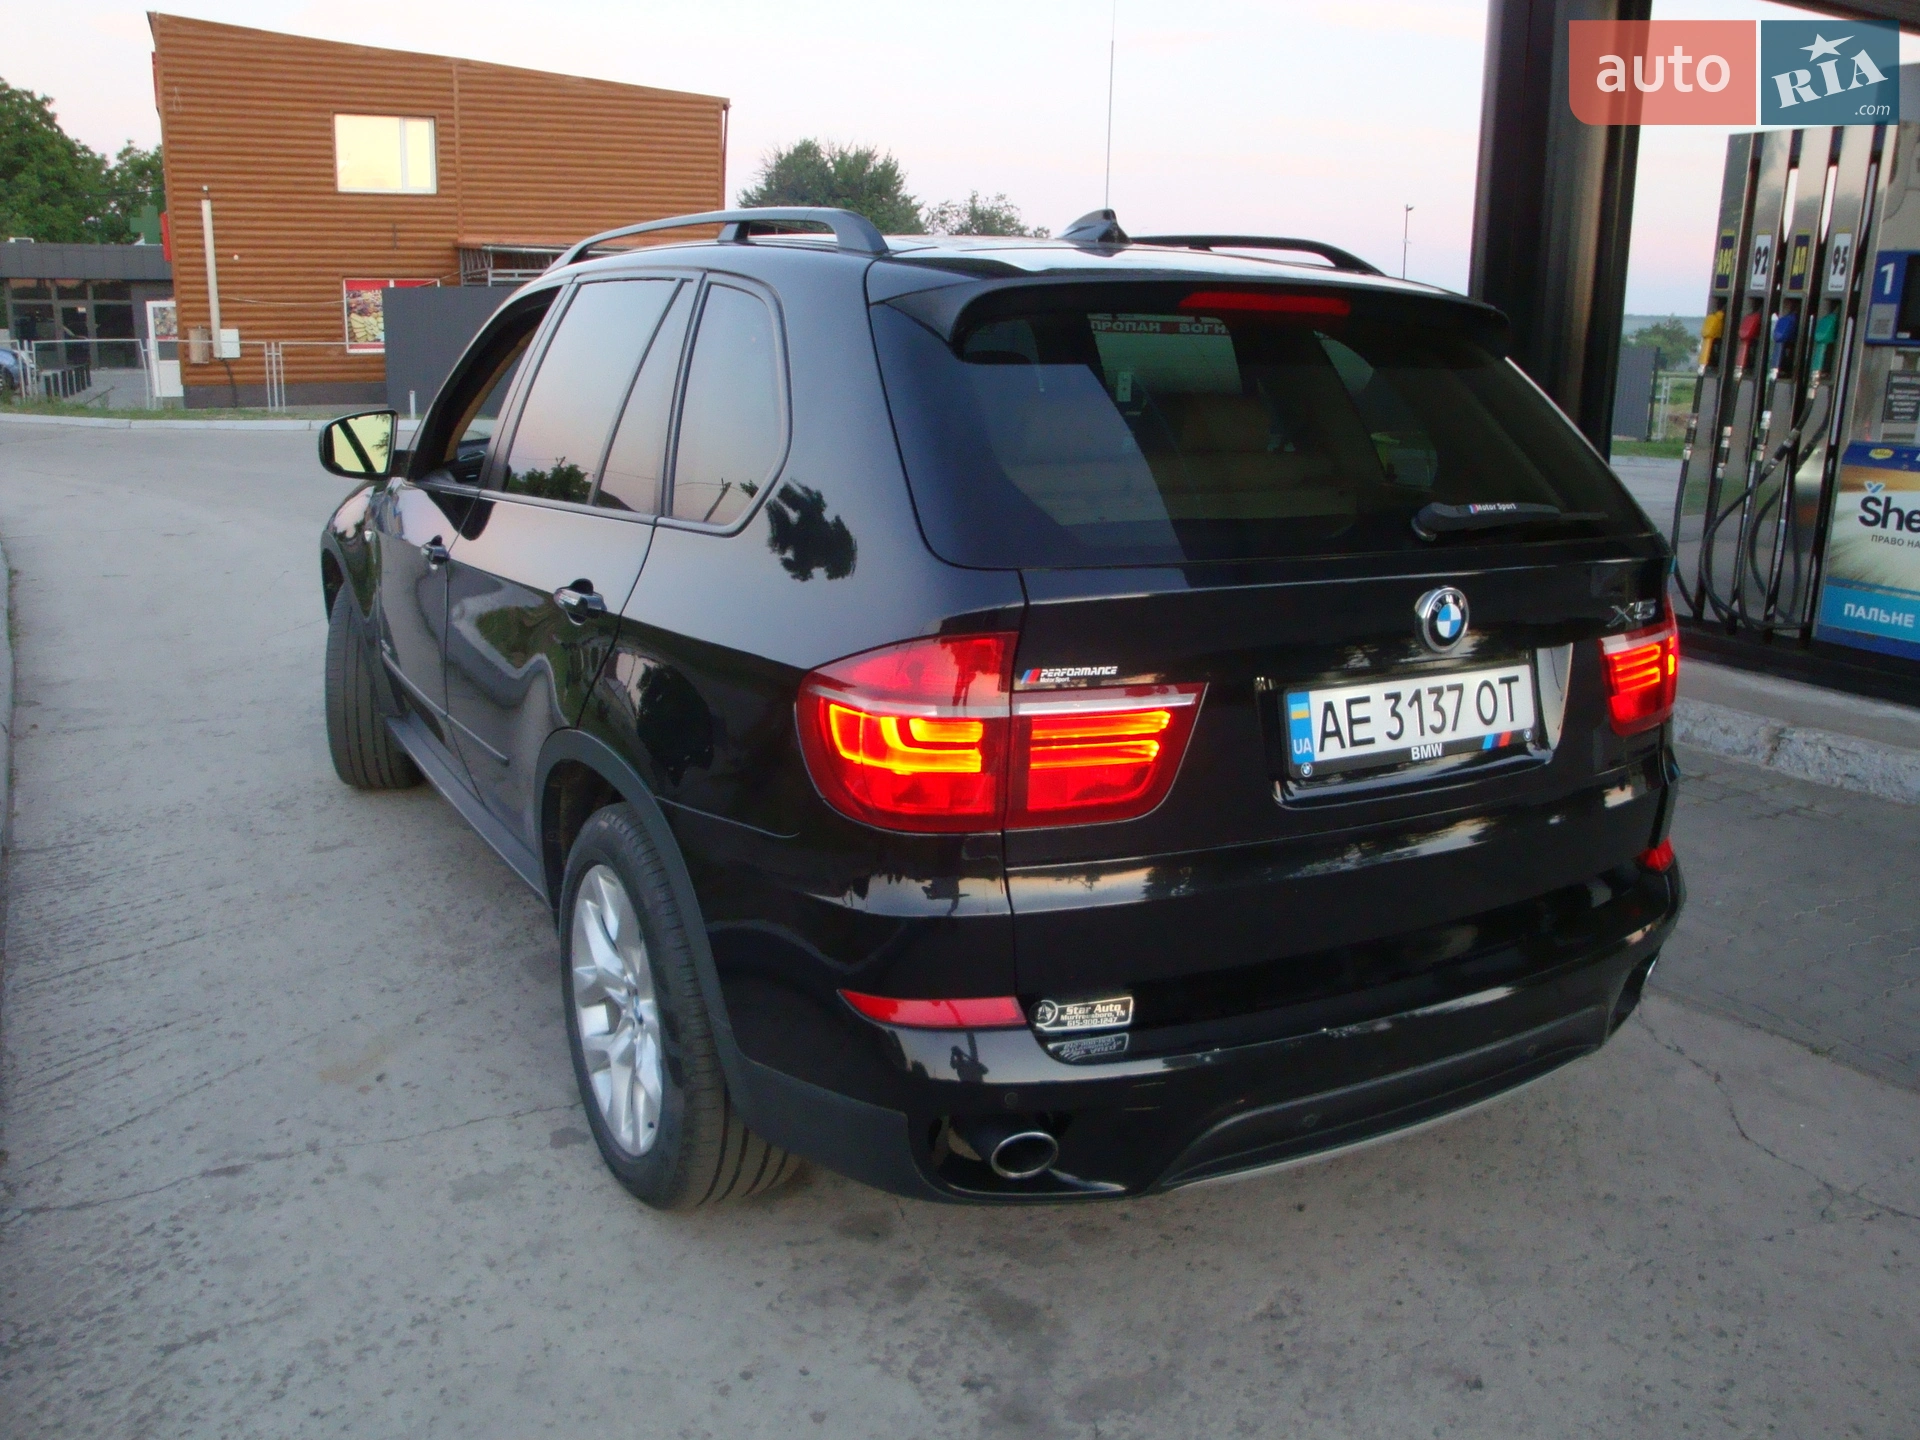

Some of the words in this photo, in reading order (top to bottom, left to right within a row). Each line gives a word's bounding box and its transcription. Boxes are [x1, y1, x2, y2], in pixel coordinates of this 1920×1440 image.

[1754, 245, 1769, 275] 92
[1832, 244, 1849, 276] 95
[1880, 262, 1896, 296] 1
[1090, 320, 1161, 333] ПРОПАН
[1179, 322, 1229, 334] ВОГН
[1870, 534, 1905, 546] ПРАВО
[1605, 598, 1657, 628] X5
[1843, 602, 1916, 628] ПАЛЬНЕ
[1040, 666, 1118, 677] PERFORMANCE
[1318, 695, 1376, 753] AE
[1384, 683, 1464, 740] 3137
[1476, 675, 1519, 726] OT
[1293, 737, 1313, 755] UA
[1411, 743, 1443, 761] BMW
[1066, 1006, 1092, 1016] Star
[1094, 1003, 1122, 1014] Auto
